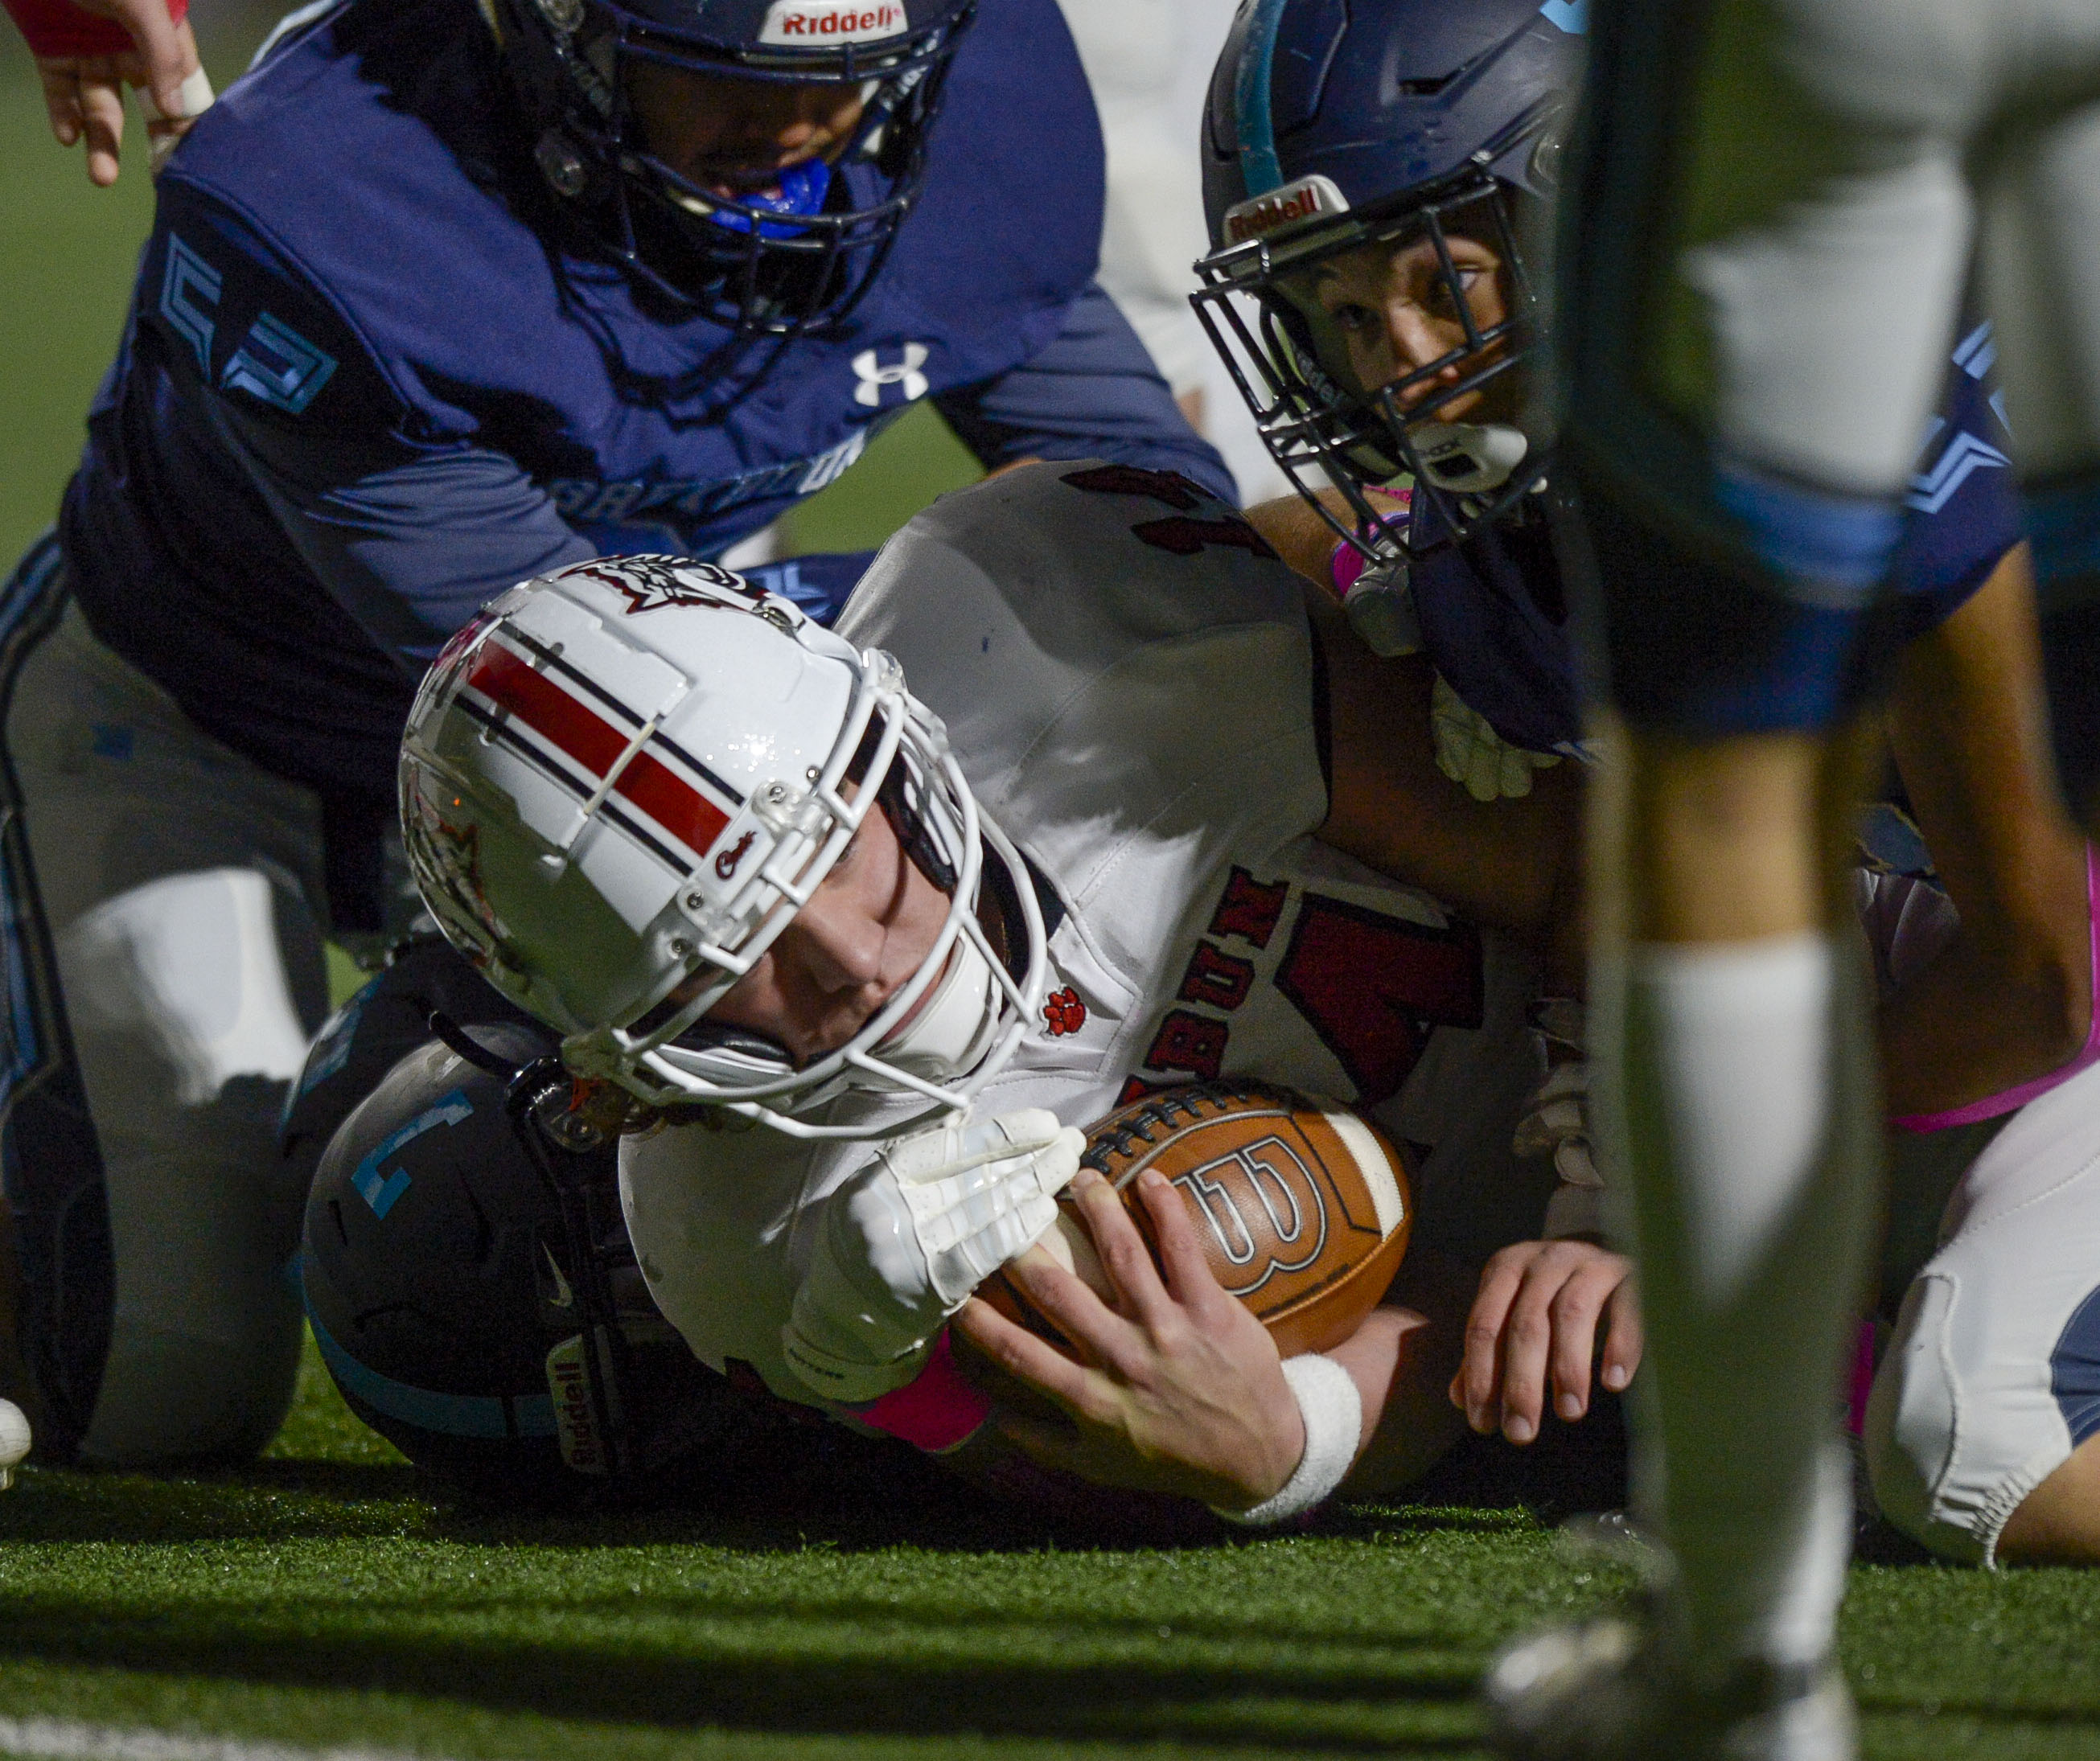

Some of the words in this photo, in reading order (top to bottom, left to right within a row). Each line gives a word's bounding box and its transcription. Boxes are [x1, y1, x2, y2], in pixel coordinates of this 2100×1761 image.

[783, 6, 894, 35] Riddell
[1229, 186, 1321, 241] Riddell
[1116, 863, 1291, 1108] BUN
[555, 1362, 597, 1466] Riddell
